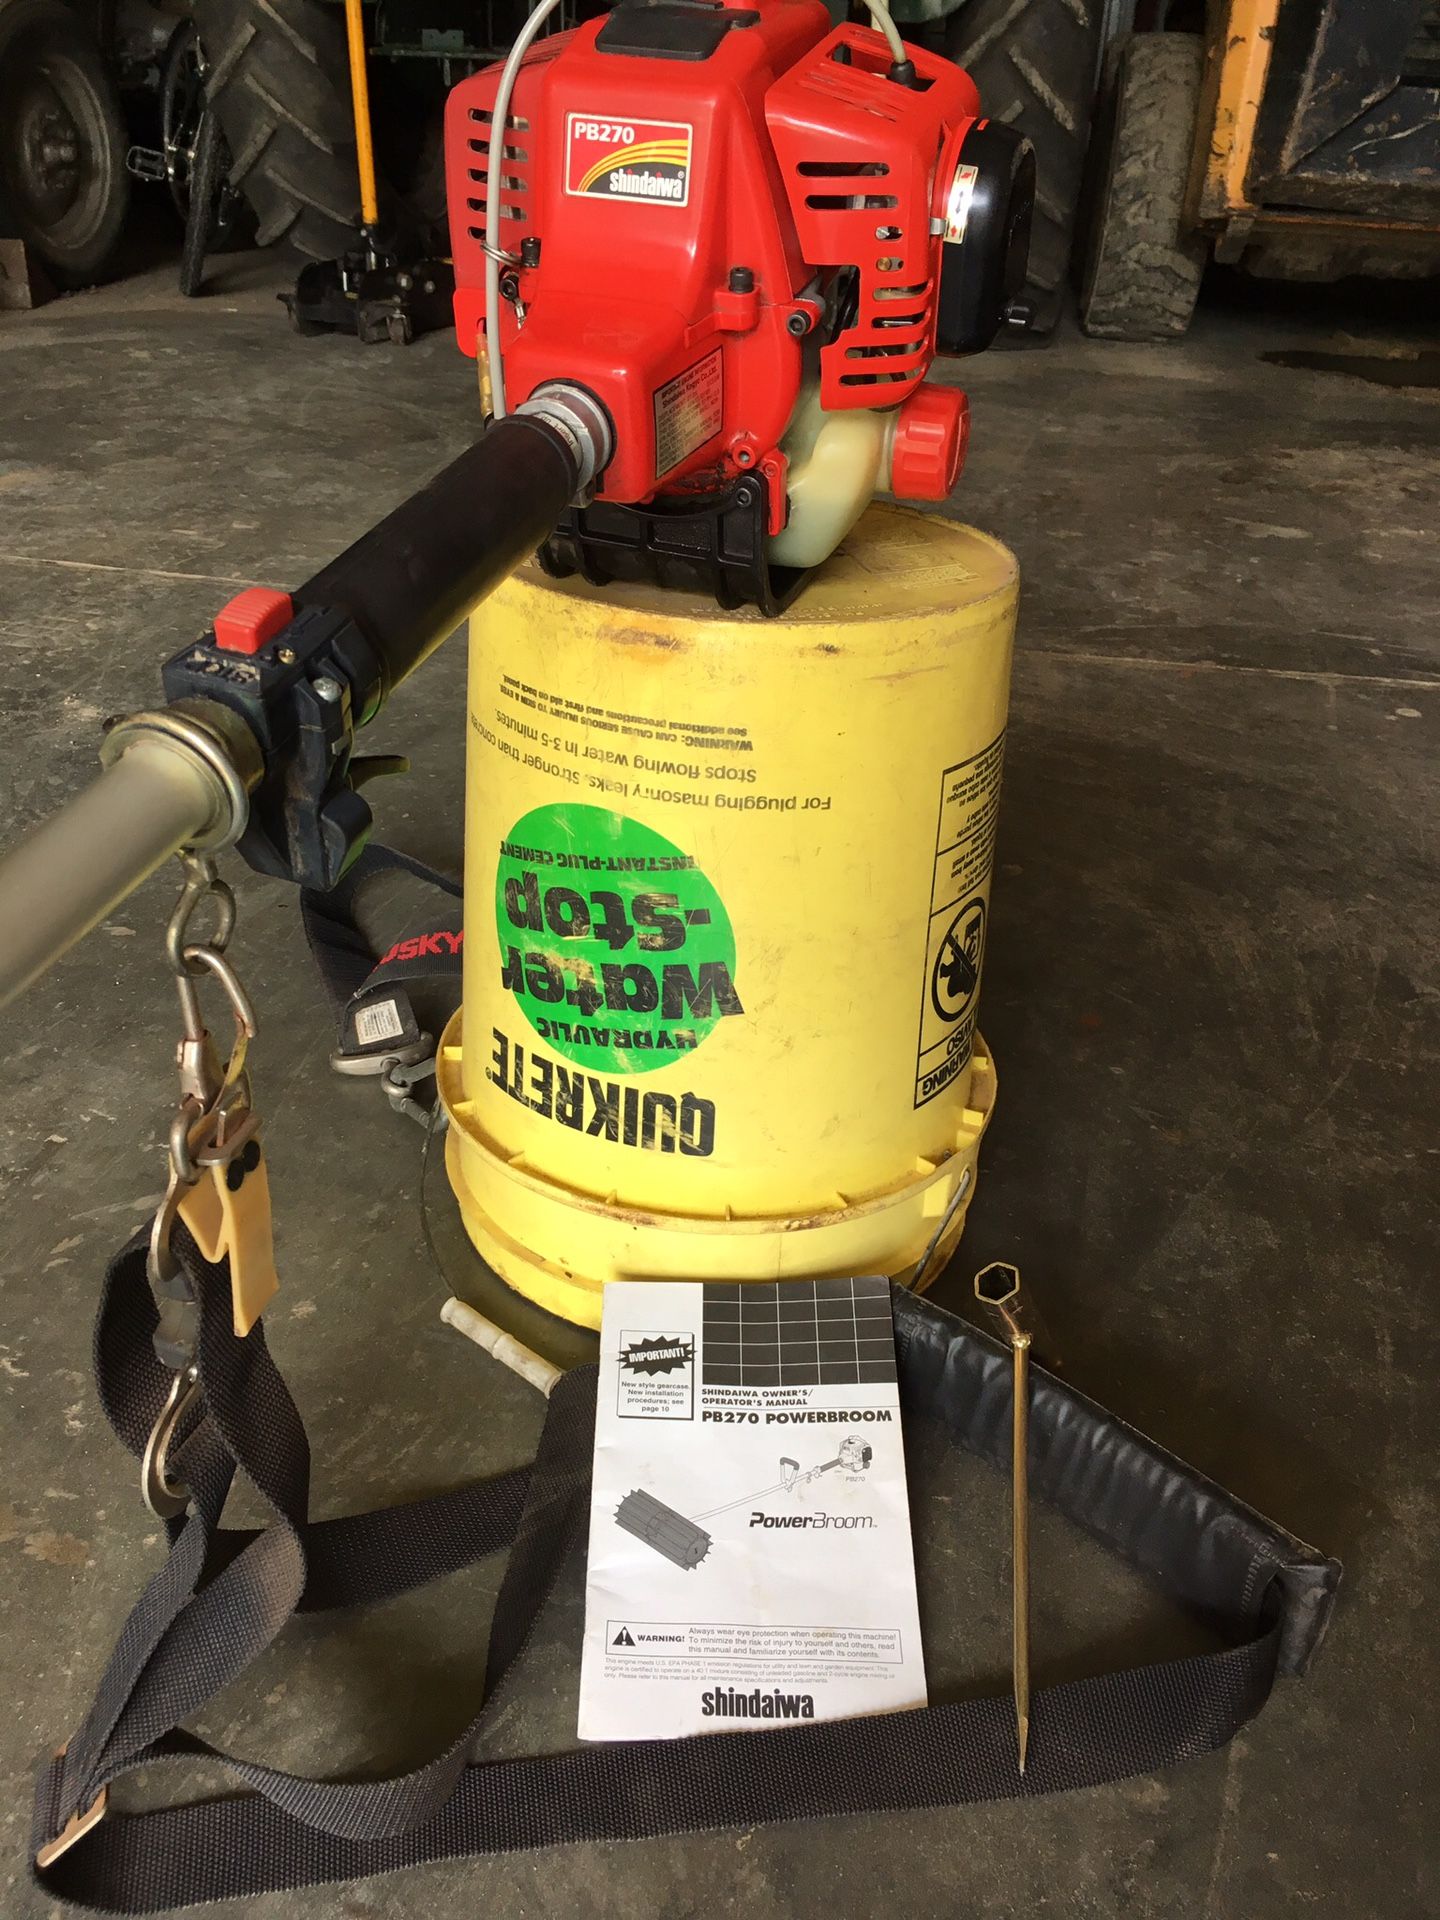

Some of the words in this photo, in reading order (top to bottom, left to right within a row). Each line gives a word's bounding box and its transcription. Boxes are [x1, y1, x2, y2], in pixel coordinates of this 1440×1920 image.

[575, 122, 635, 144] PB270
[609, 168, 683, 198] shindaiwa
[521, 684, 537, 698] back
[539, 692, 548, 701] on
[538, 703, 547, 713] TO
[550, 696, 563, 706] aid
[564, 700, 584, 712] first
[550, 708, 578, 723] INJURY
[586, 707, 604, 717] and
[606, 711, 666, 728] precautions
[495, 708, 538, 740] minutes.
[581, 716, 619, 732] SERIOUS
[621, 726, 653, 738] CAUSE
[669, 722, 725, 735] additional
[655, 732, 677, 742] CAN
[727, 728, 747, 737] See
[541, 732, 561, 750] 3-5
[565, 740, 578, 756] in
[681, 735, 753, 751] WARNING:
[497, 739, 519, 761] than
[582, 745, 629, 768] water
[522, 753, 580, 784] Stronger
[633, 756, 700, 779] flowing
[705, 766, 756, 783] Stops
[632, 784, 709, 808] masonry
[715, 795, 797, 811] plugging
[801, 796, 831, 811] For
[499, 841, 554, 864] CEMENT
[501, 946, 744, 1020] Water
[536, 1017, 697, 1049] HYDRAULIC
[491, 1027, 716, 1157] QUIKRETE
[629, 1347, 684, 1362] IMPORTANT!
[702, 1388, 758, 1397] SHINDAIWA
[701, 1397, 762, 1406] OPERATOR'S
[702, 1411, 759, 1424] PB270
[765, 1410, 892, 1424] POWERBROOM
[750, 1512, 873, 1528] PowerBroom
[637, 1634, 685, 1643] WARNING!
[804, 1640, 833, 1648] yourself
[812, 1632, 846, 1640] operating
[702, 1686, 814, 1718] shindaiwa
